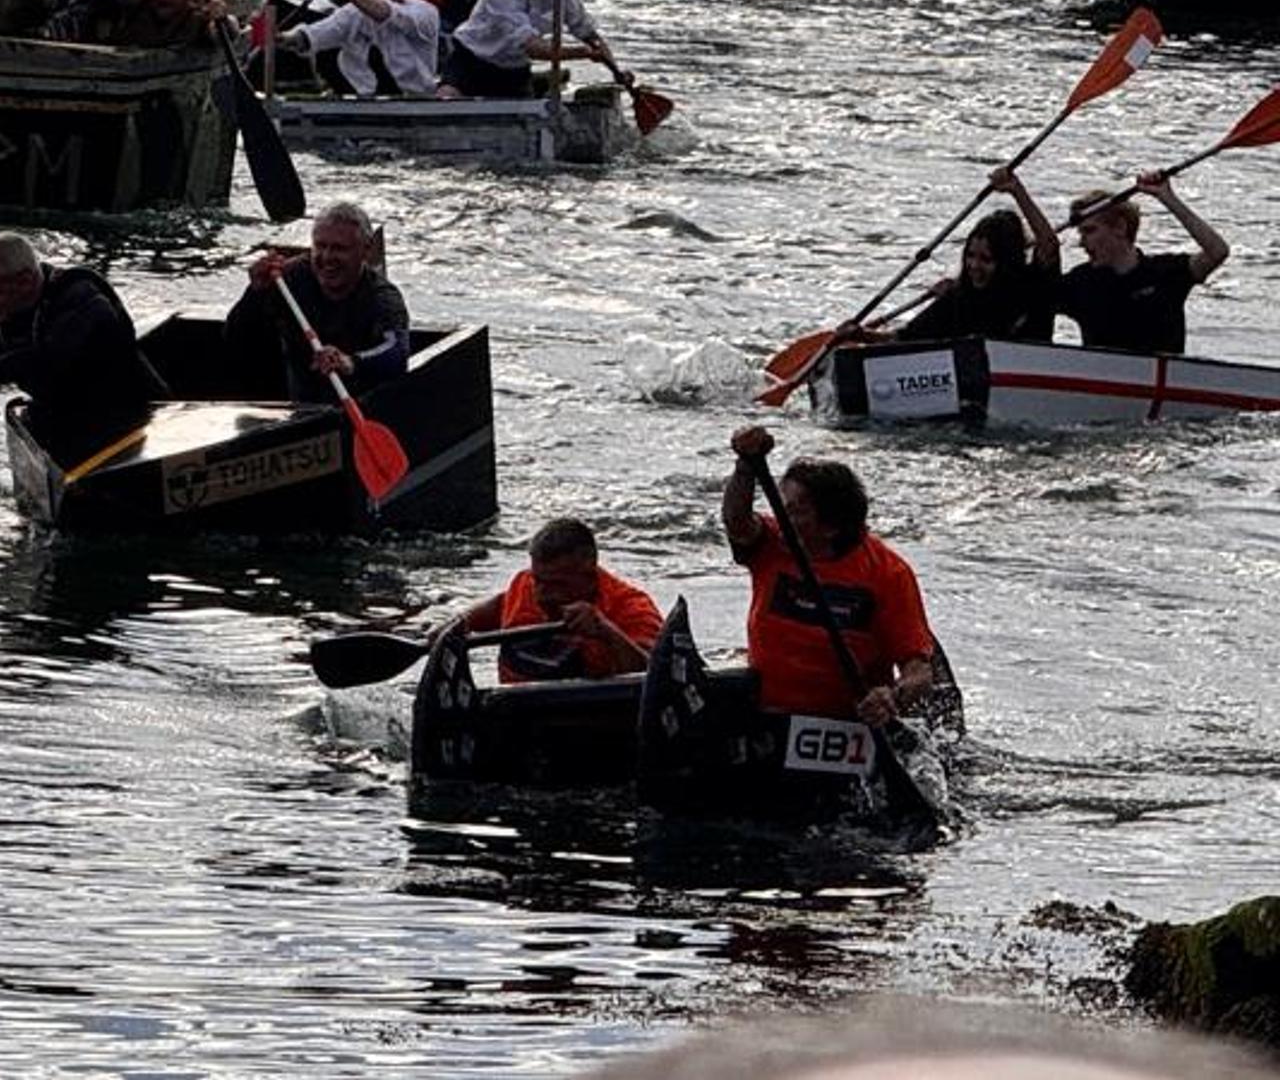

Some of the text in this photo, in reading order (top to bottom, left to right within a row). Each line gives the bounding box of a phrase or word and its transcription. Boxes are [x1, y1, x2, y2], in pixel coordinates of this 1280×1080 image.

[896, 372, 953, 391] TADEK
[219, 439, 332, 488] TOHATSU
[796, 728, 867, 764] GB1
